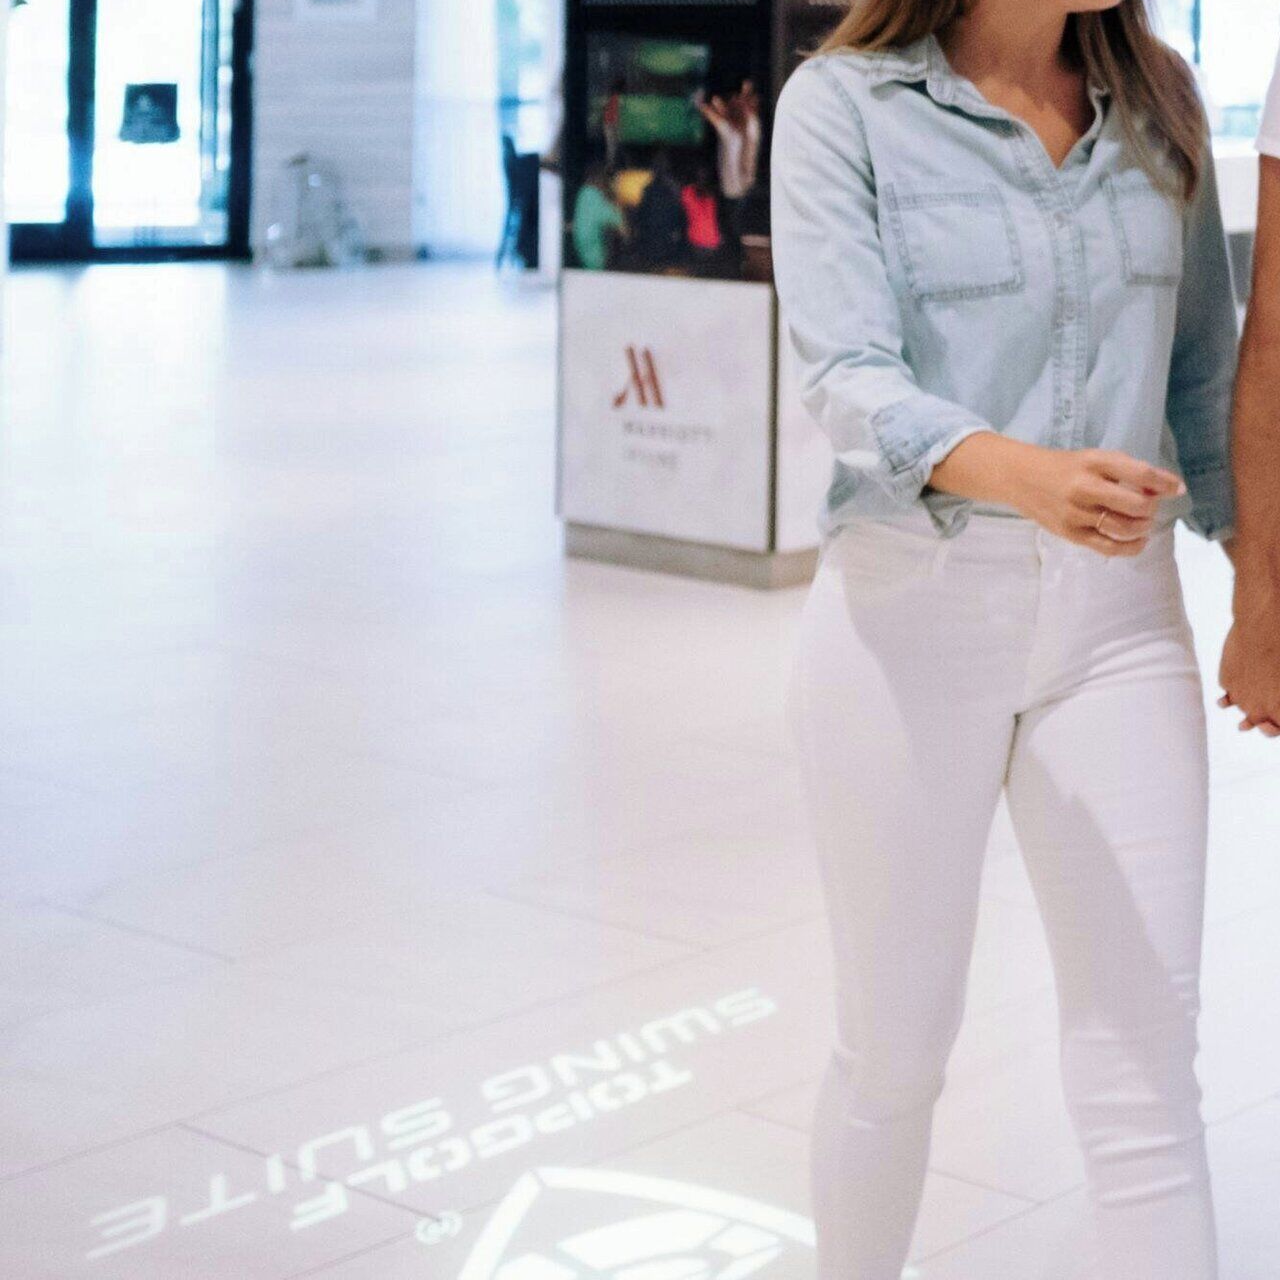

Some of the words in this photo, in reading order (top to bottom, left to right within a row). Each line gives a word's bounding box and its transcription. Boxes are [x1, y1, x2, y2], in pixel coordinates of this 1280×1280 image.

[480, 988, 778, 1113] SWING
[84, 1097, 452, 1261] SUITE
[288, 1057, 692, 1232] TOPGOLF
